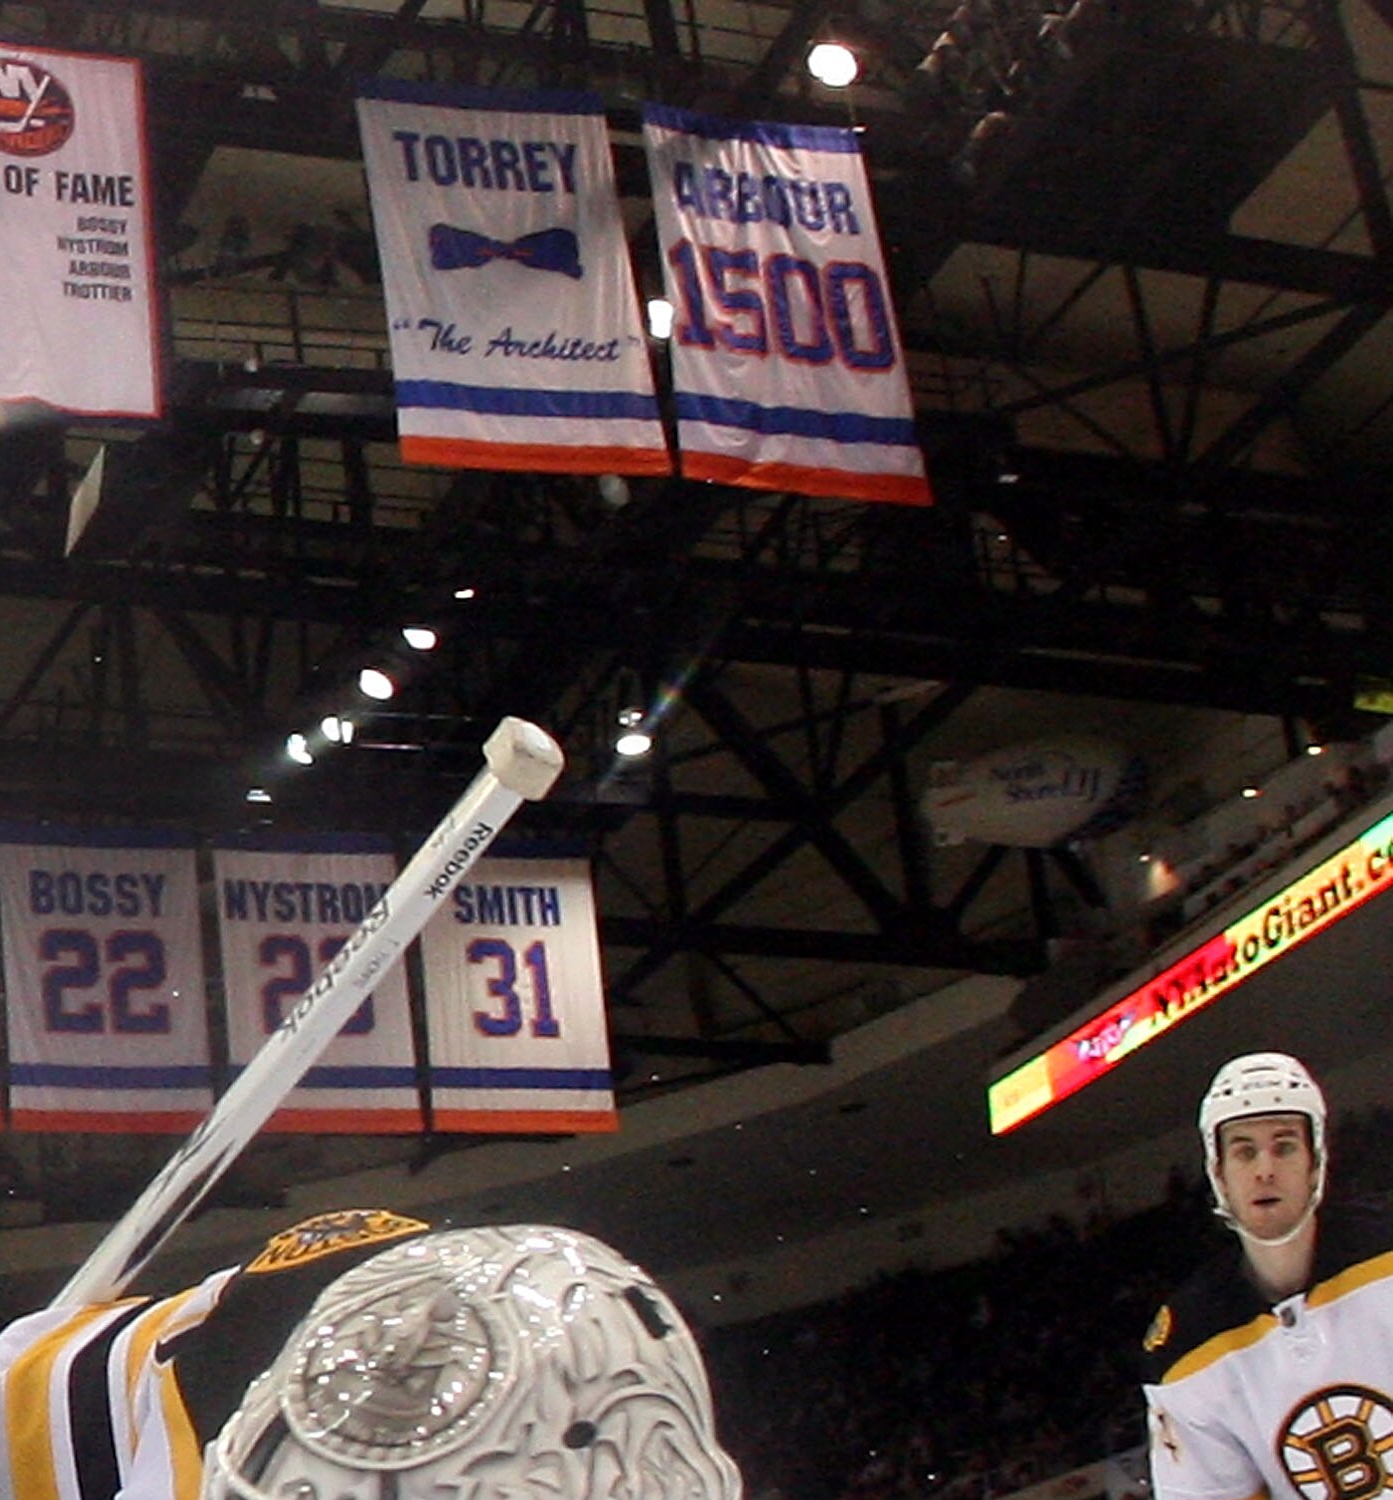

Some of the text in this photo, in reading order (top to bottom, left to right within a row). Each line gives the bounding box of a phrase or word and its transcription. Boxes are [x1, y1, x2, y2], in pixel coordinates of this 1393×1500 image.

[3, 163, 40, 196] OF
[55, 171, 135, 207] FAME
[393, 131, 578, 193] TORREY
[671, 162, 860, 236] ARBOUR
[57, 235, 129, 256] NYSTROM
[63, 281, 133, 302] TROTTIER
[668, 236, 896, 374] 1500
[424, 821, 496, 900] Reebok
[29, 871, 166, 917] BOSSY
[454, 883, 562, 926] SMITH
[38, 928, 173, 1035] 22
[466, 937, 562, 1040] 31
